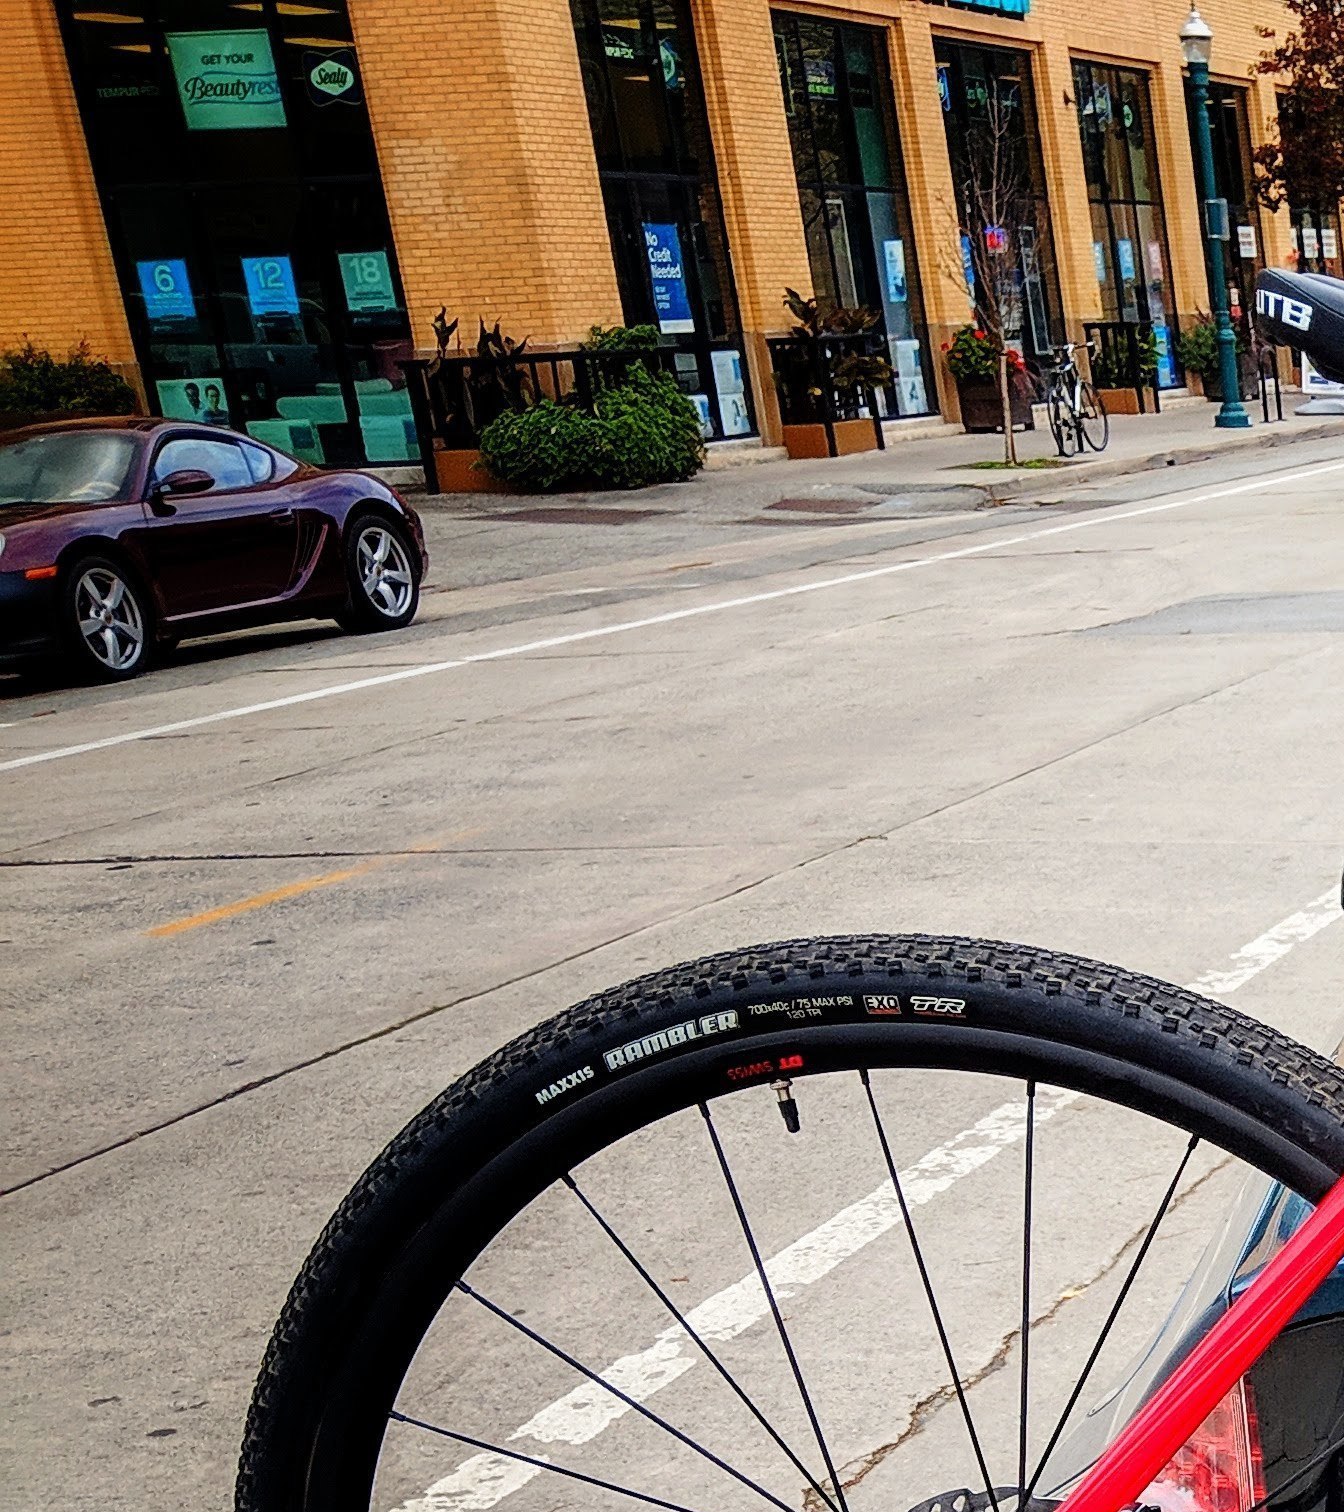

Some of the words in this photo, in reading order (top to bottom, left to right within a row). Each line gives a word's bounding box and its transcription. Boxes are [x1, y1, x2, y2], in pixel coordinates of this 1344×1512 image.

[202, 54, 222, 65] GET
[225, 53, 254, 64] YOUR
[316, 67, 347, 87] Sealy
[645, 231, 658, 246] No
[648, 247, 672, 262] Credit
[154, 264, 175, 292] 6
[252, 262, 284, 288] 12
[350, 257, 381, 283] 18
[651, 263, 681, 278] Needed
[799, 999, 810, 1009] 75
[812, 997, 835, 1008] MAX
[866, 996, 898, 1009] EXO
[910, 996, 967, 1014] TR
[535, 1066, 594, 1105] MAXXIS
[603, 1010, 740, 1072] RAMBLER
